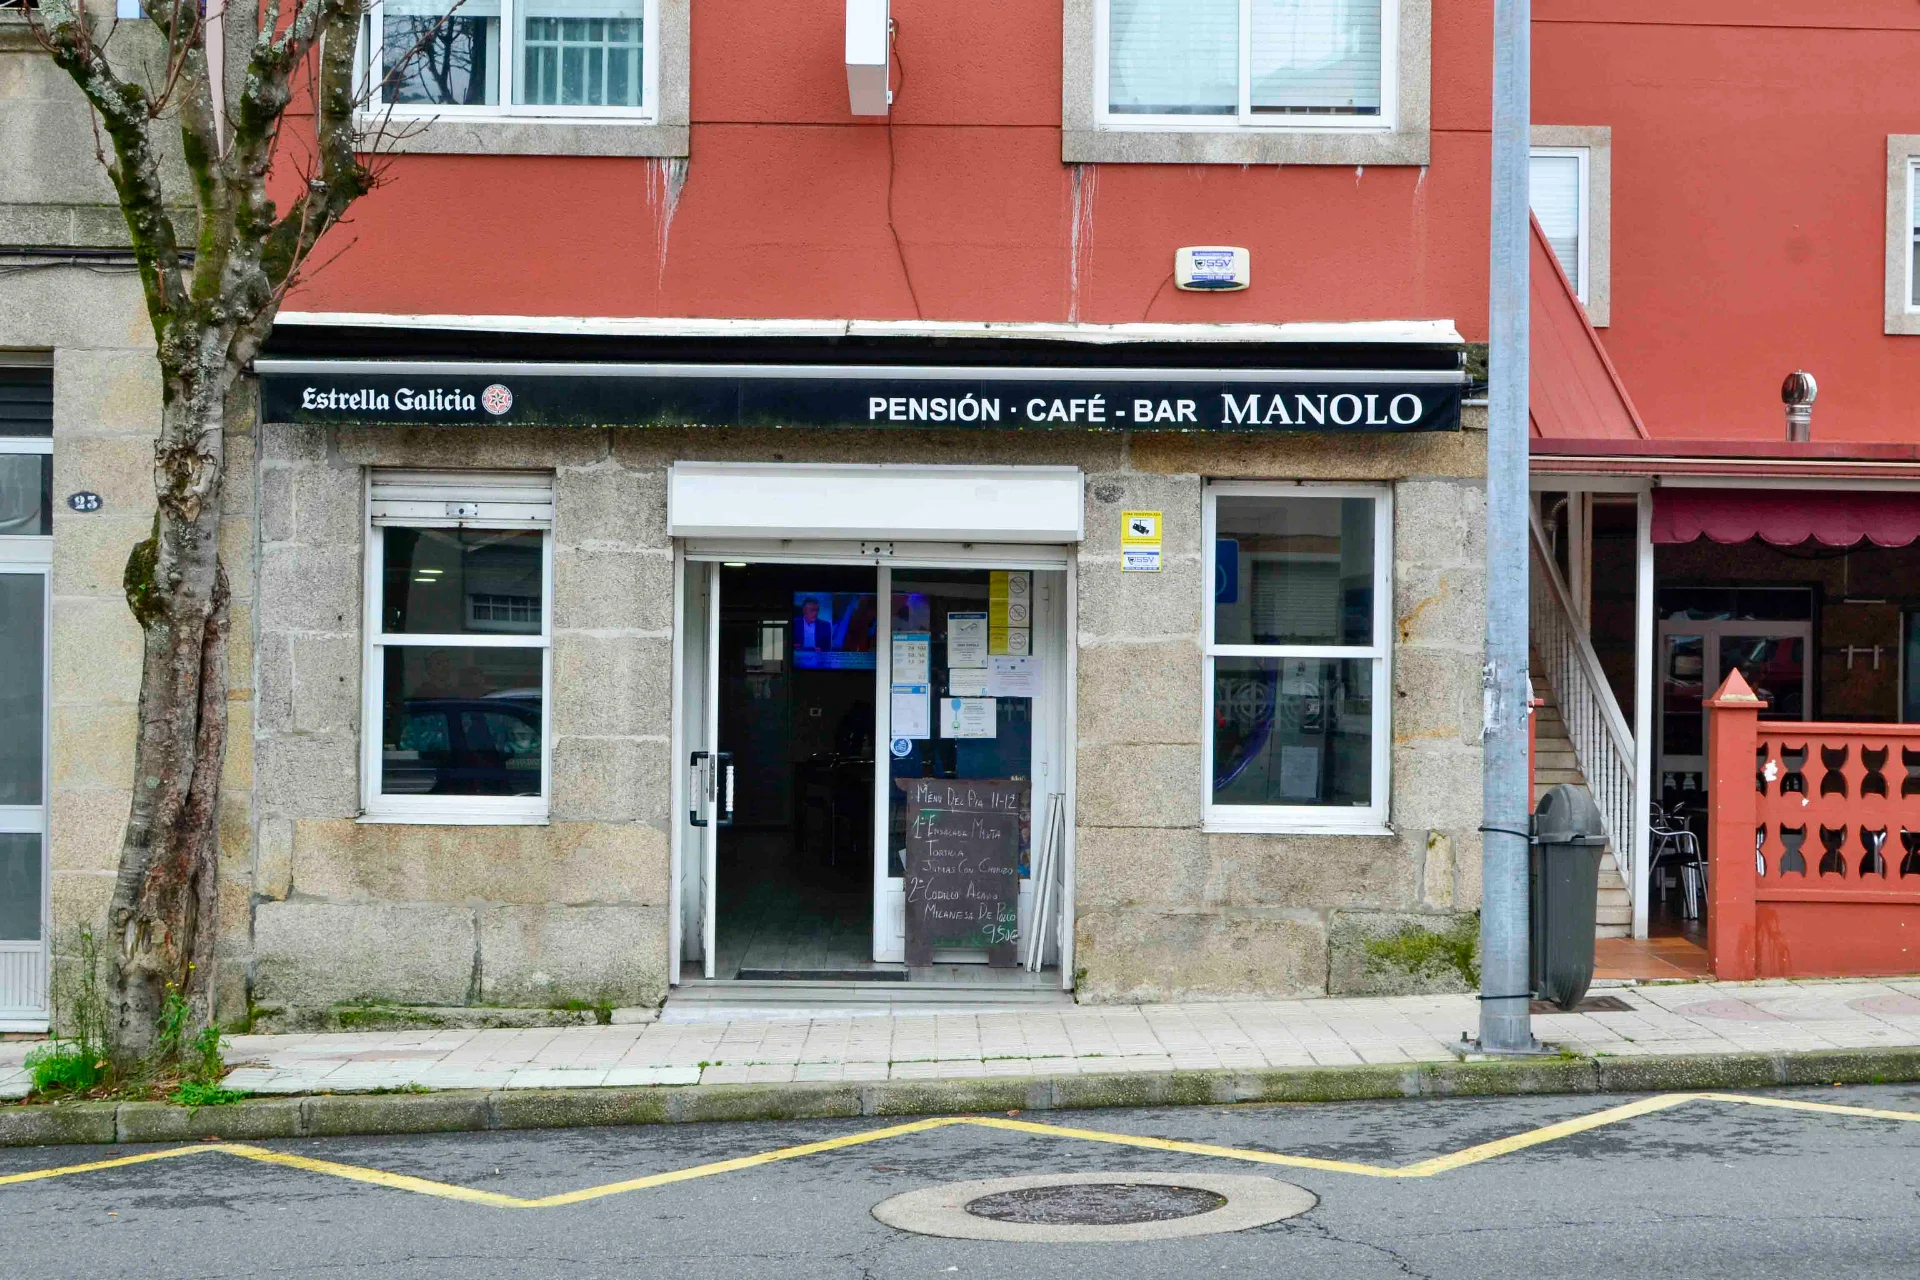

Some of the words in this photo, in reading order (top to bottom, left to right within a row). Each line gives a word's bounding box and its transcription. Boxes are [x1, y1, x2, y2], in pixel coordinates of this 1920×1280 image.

[301, 386, 390, 411] Estrella
[394, 387, 477, 412] Galicia
[869, 393, 1000, 422] PENSIÓN
[1026, 394, 1106, 423] CAFÉ
[1134, 399, 1197, 423] BAR
[1221, 393, 1423, 425] MANOLO
